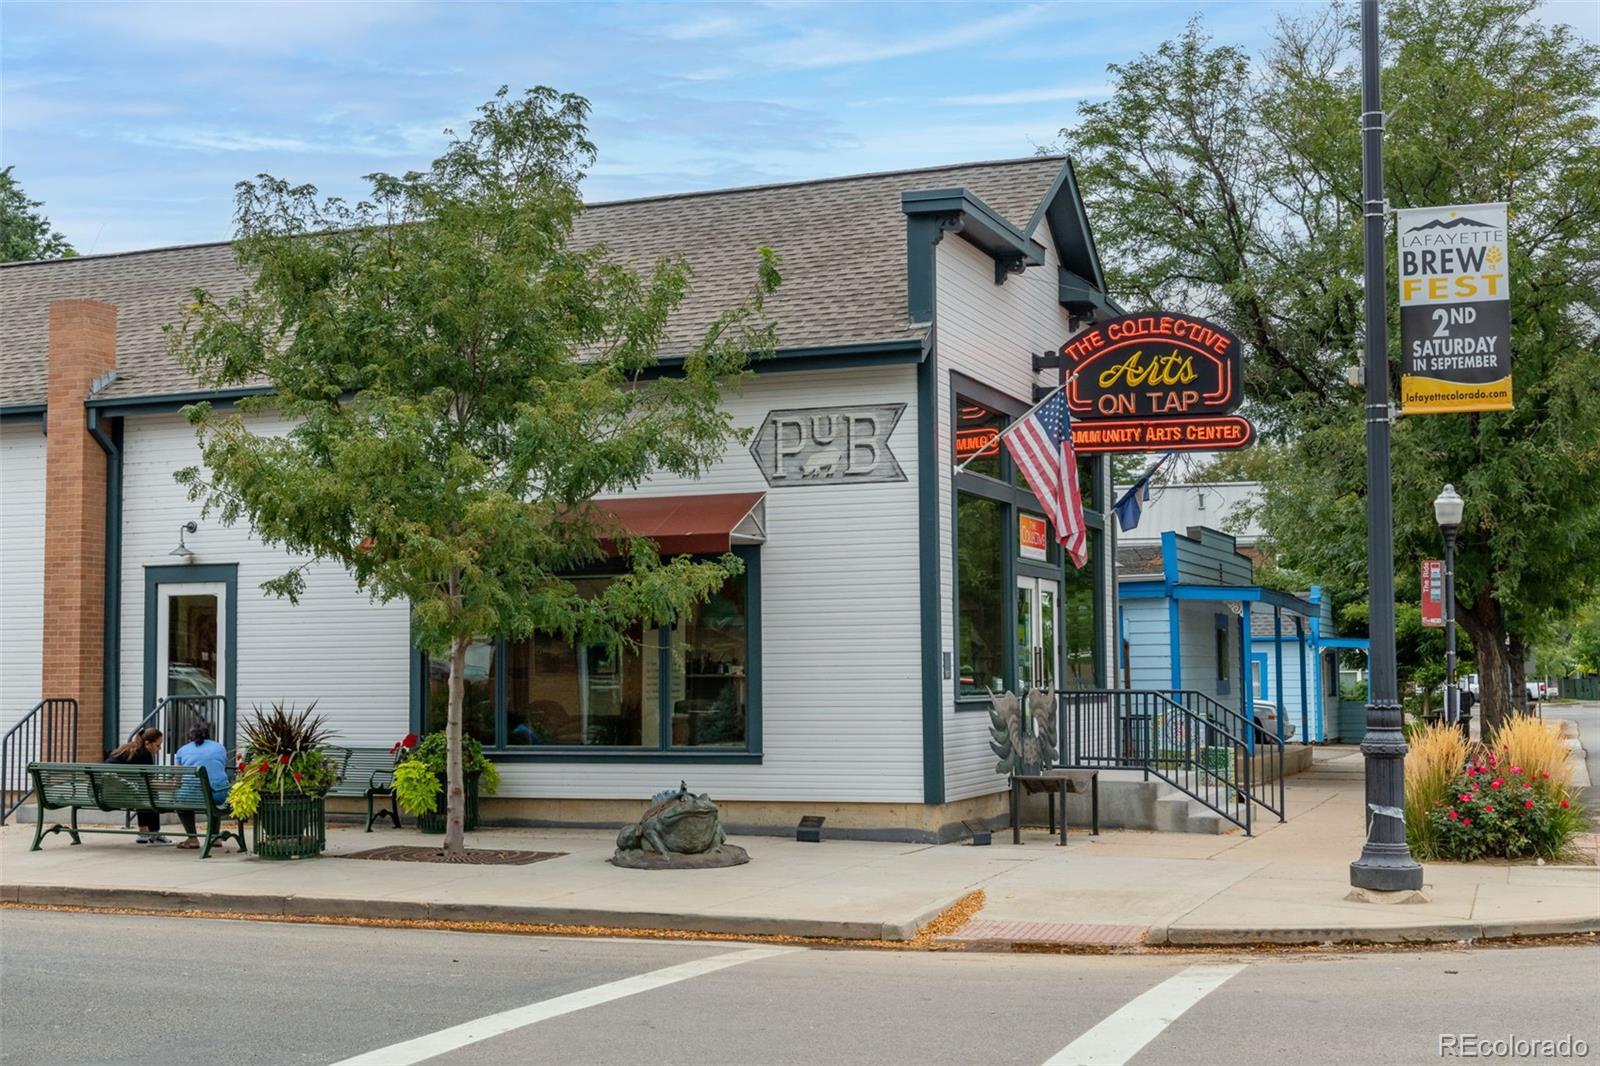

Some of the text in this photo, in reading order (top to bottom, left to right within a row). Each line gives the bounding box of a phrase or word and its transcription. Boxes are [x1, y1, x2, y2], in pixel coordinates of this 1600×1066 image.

[1402, 230, 1503, 249] LAFAYETTE
[1402, 246, 1487, 276] BREW
[1403, 274, 1504, 301] FEST
[1432, 306, 1477, 338] 2ND
[1064, 316, 1232, 362] THE COLLECTIVE
[1412, 336, 1498, 358] SATURDAY
[1098, 349, 1199, 389] Arts
[1413, 354, 1498, 372] IN SEPTEMBER
[1098, 390, 1200, 416] ON TAP
[1405, 389, 1508, 404] lafayettecolorado.com
[1072, 425, 1242, 444] OMMUNITY ARTS CENTER
